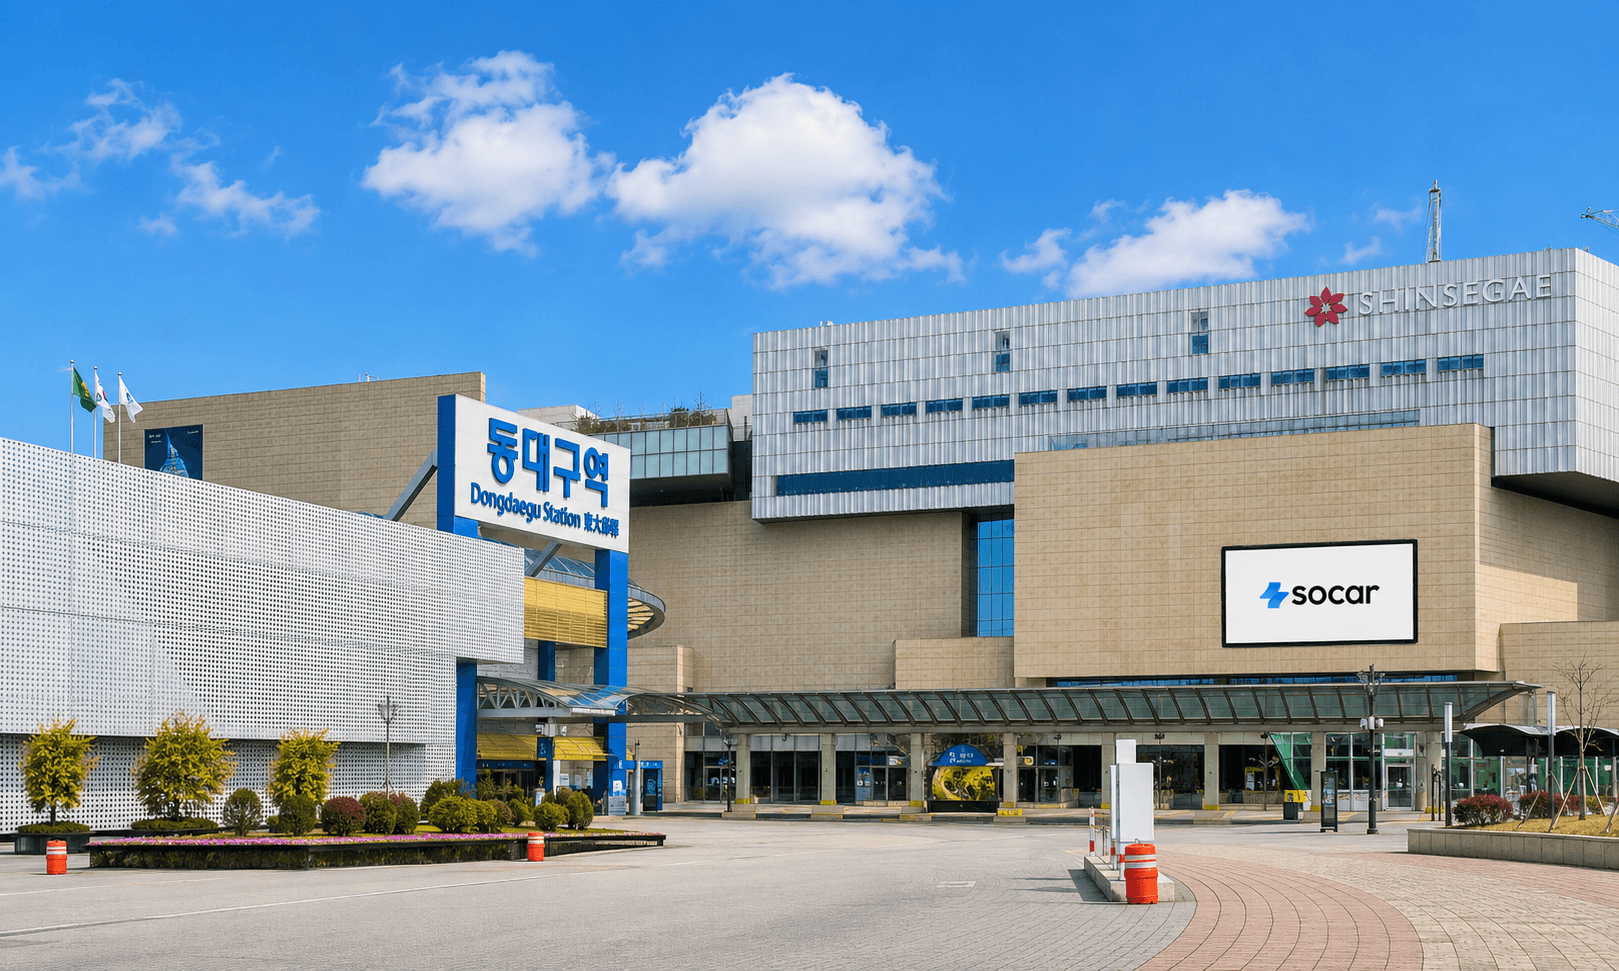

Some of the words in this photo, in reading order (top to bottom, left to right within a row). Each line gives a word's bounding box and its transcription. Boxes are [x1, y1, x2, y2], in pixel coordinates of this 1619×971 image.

[1358, 275, 1552, 315] SHINSEGAE
[487, 417, 609, 508] 동대구역
[471, 482, 541, 523] Dongdaegu
[542, 502, 581, 529] Station
[1292, 585, 1380, 605] socar
